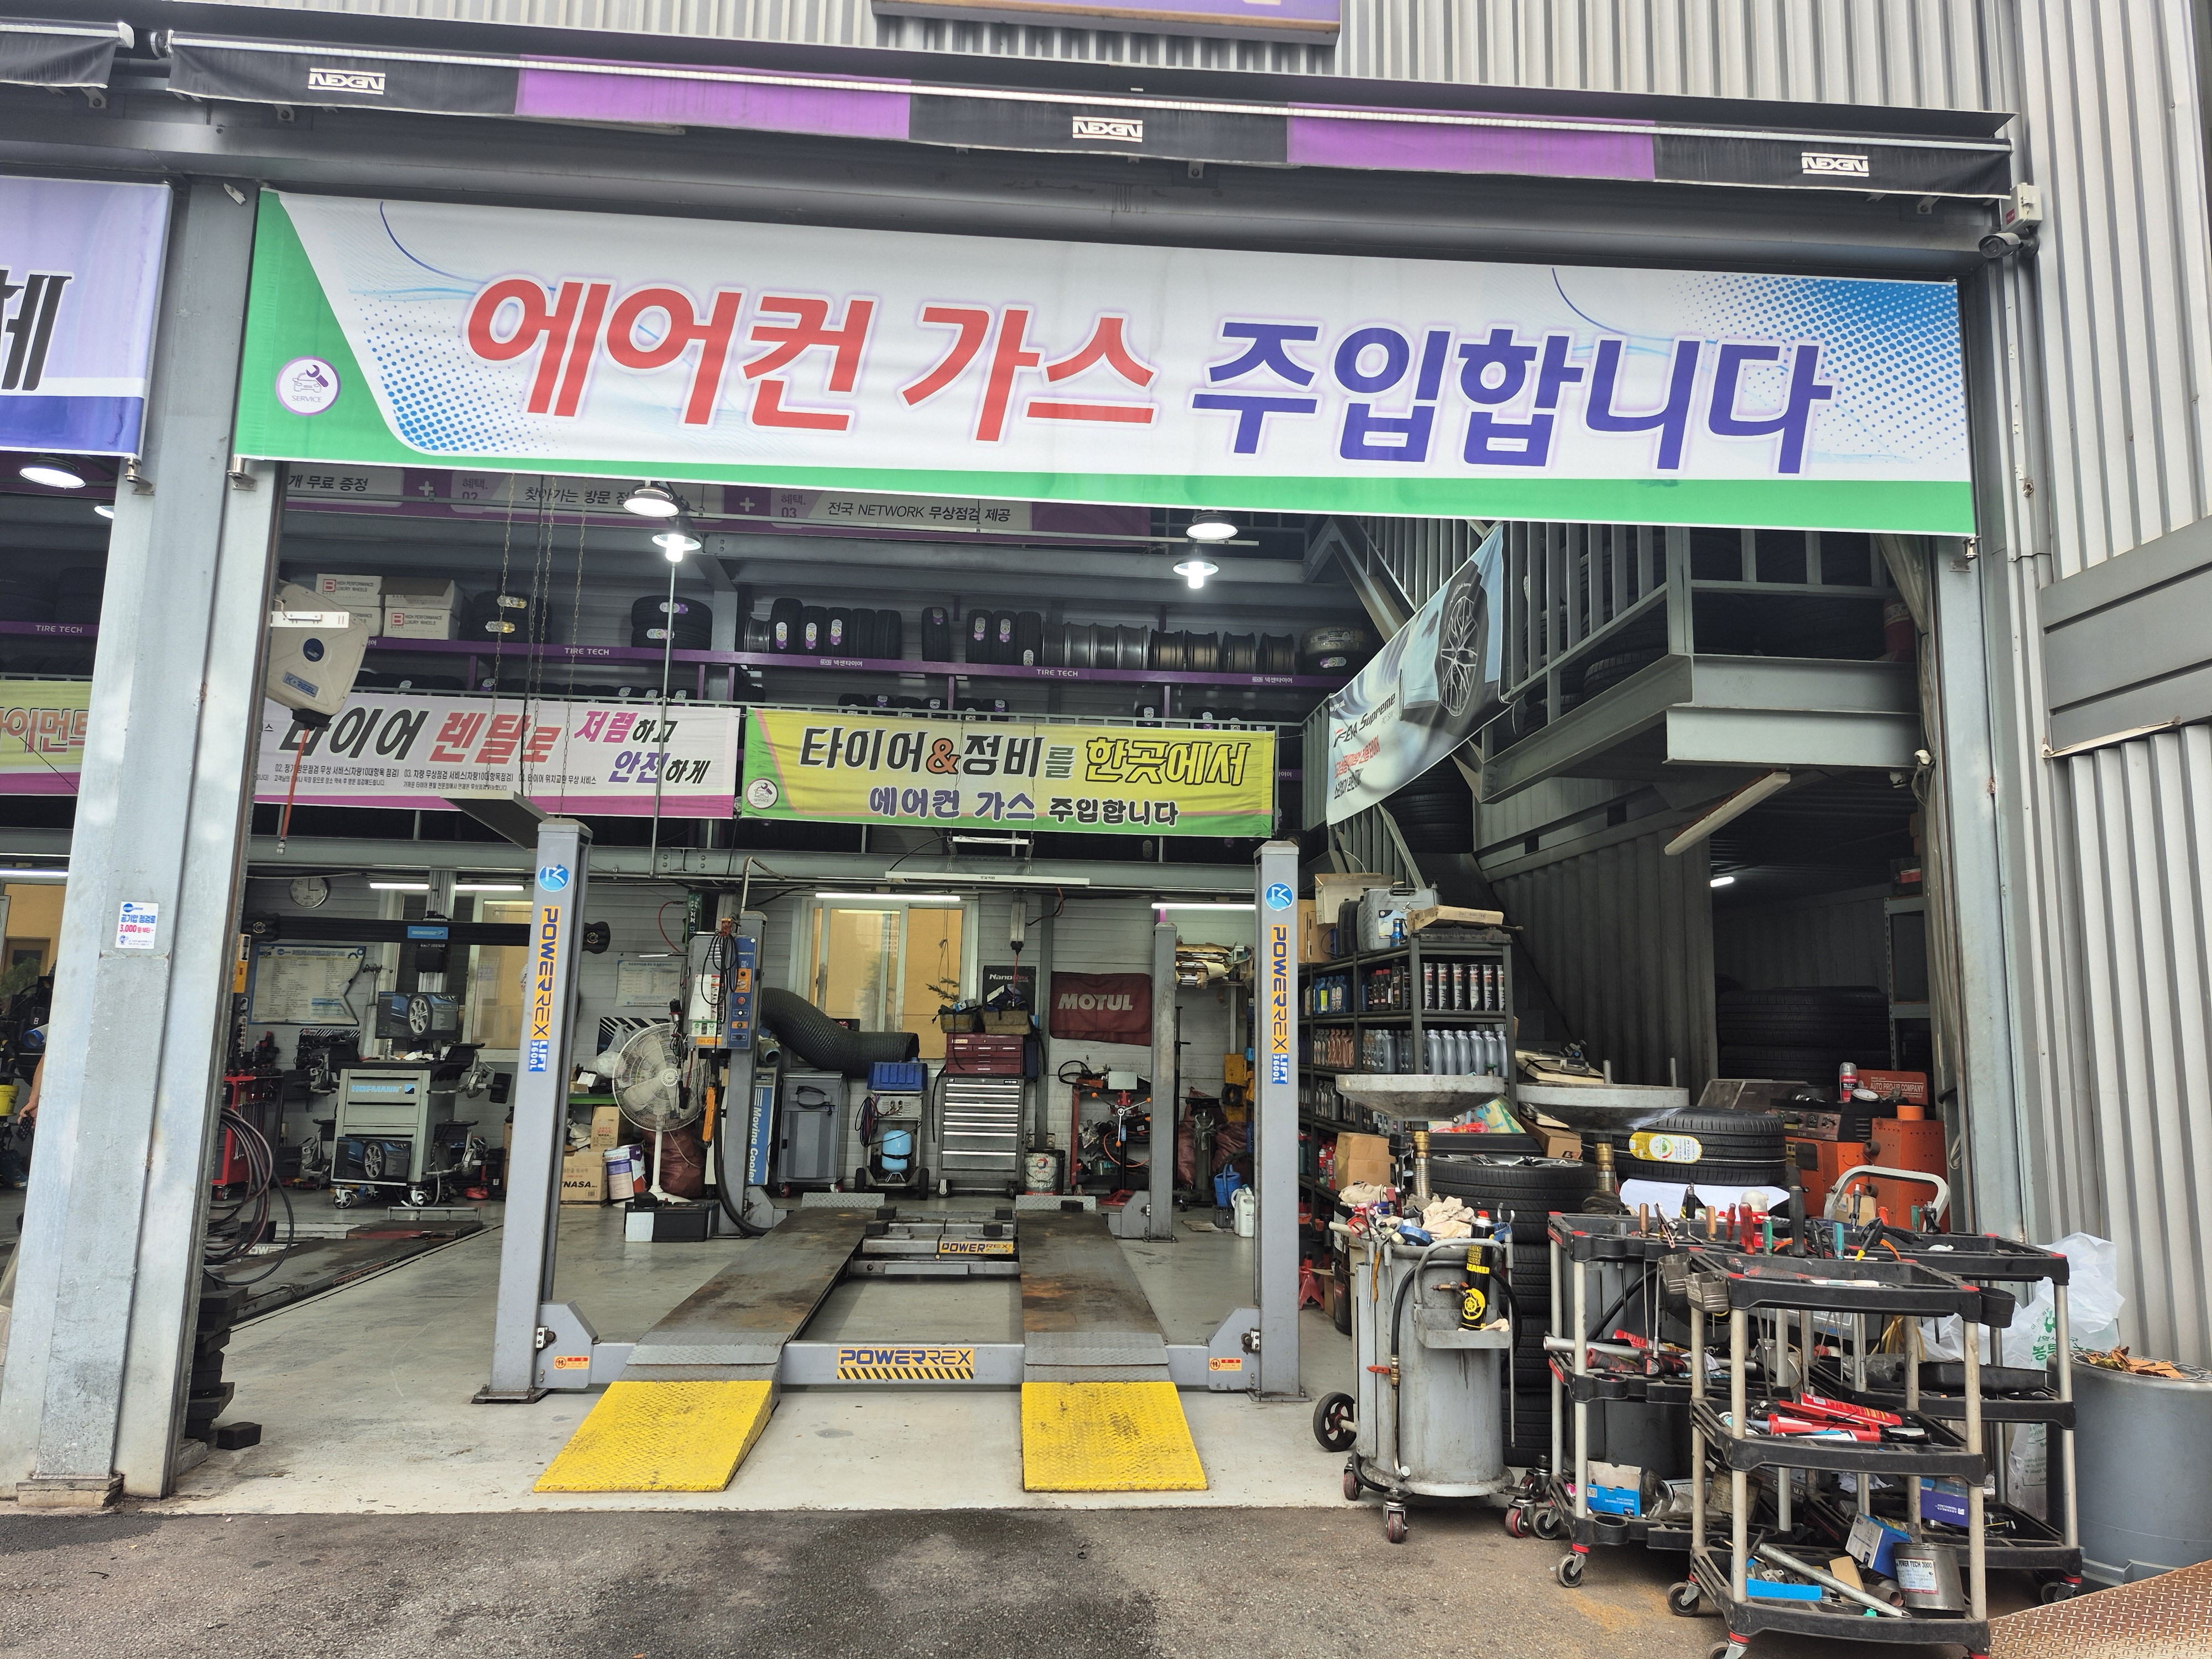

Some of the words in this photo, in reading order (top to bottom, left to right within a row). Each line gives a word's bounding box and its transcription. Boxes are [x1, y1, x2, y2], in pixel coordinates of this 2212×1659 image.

[309, 68, 385, 94] NEXEN
[1072, 116, 1142, 143] NEXEN
[1801, 152, 1869, 178] NEXEN
[467, 278, 875, 432] 에어컨
[902, 305, 1155, 441] 가스
[1192, 322, 1833, 474] 주입합니다
[291, 395, 322, 404] SERVICE
[306, 475, 335, 489] 무료
[340, 477, 368, 492] 증정
[525, 486, 579, 503] 찾아가는
[585, 490, 611, 504] 방문
[781, 508, 797, 518] 03
[828, 502, 854, 515] 전국
[858, 504, 924, 518] NETWORK
[928, 506, 979, 521] 무상점검
[985, 508, 1011, 523] 제공
[1057, 670, 1078, 678] TECH
[1359, 692, 1396, 731] Supreme
[429, 711, 562, 765] 렌탈로
[574, 711, 679, 743] 저렴하고
[608, 750, 711, 784] 안전하게
[800, 727, 1075, 779] 타이어&정비를
[1085, 737, 1251, 786] 한곳에서
[320, 765, 332, 775] 무상
[414, 769, 424, 779] 차량
[426, 770, 447, 780] 무상점검
[568, 776, 580, 785] 무상
[581, 776, 597, 785] 서비스
[870, 787, 959, 818] 에어컨
[975, 792, 1035, 820] 가스
[1048, 797, 1177, 826] 주입합니다
[119, 924, 137, 933] 3,000
[121, 914, 138, 923] 공기압
[139, 915, 156, 924] 점검료
[533, 907, 559, 1037] POWERREX
[1273, 926, 1287, 1051] POWERREX
[1057, 993, 1133, 1011] MOTUL
[529, 1041, 539, 1071] 3600L
[538, 1041, 549, 1071] LIFT
[1280, 1055, 1288, 1083] LIFT
[1870, 1082, 1882, 1091] AUTO
[1901, 1083, 1924, 1093] COMPANY
[748, 1147, 759, 1184] Cooler
[841, 1350, 971, 1365] POWERREX
